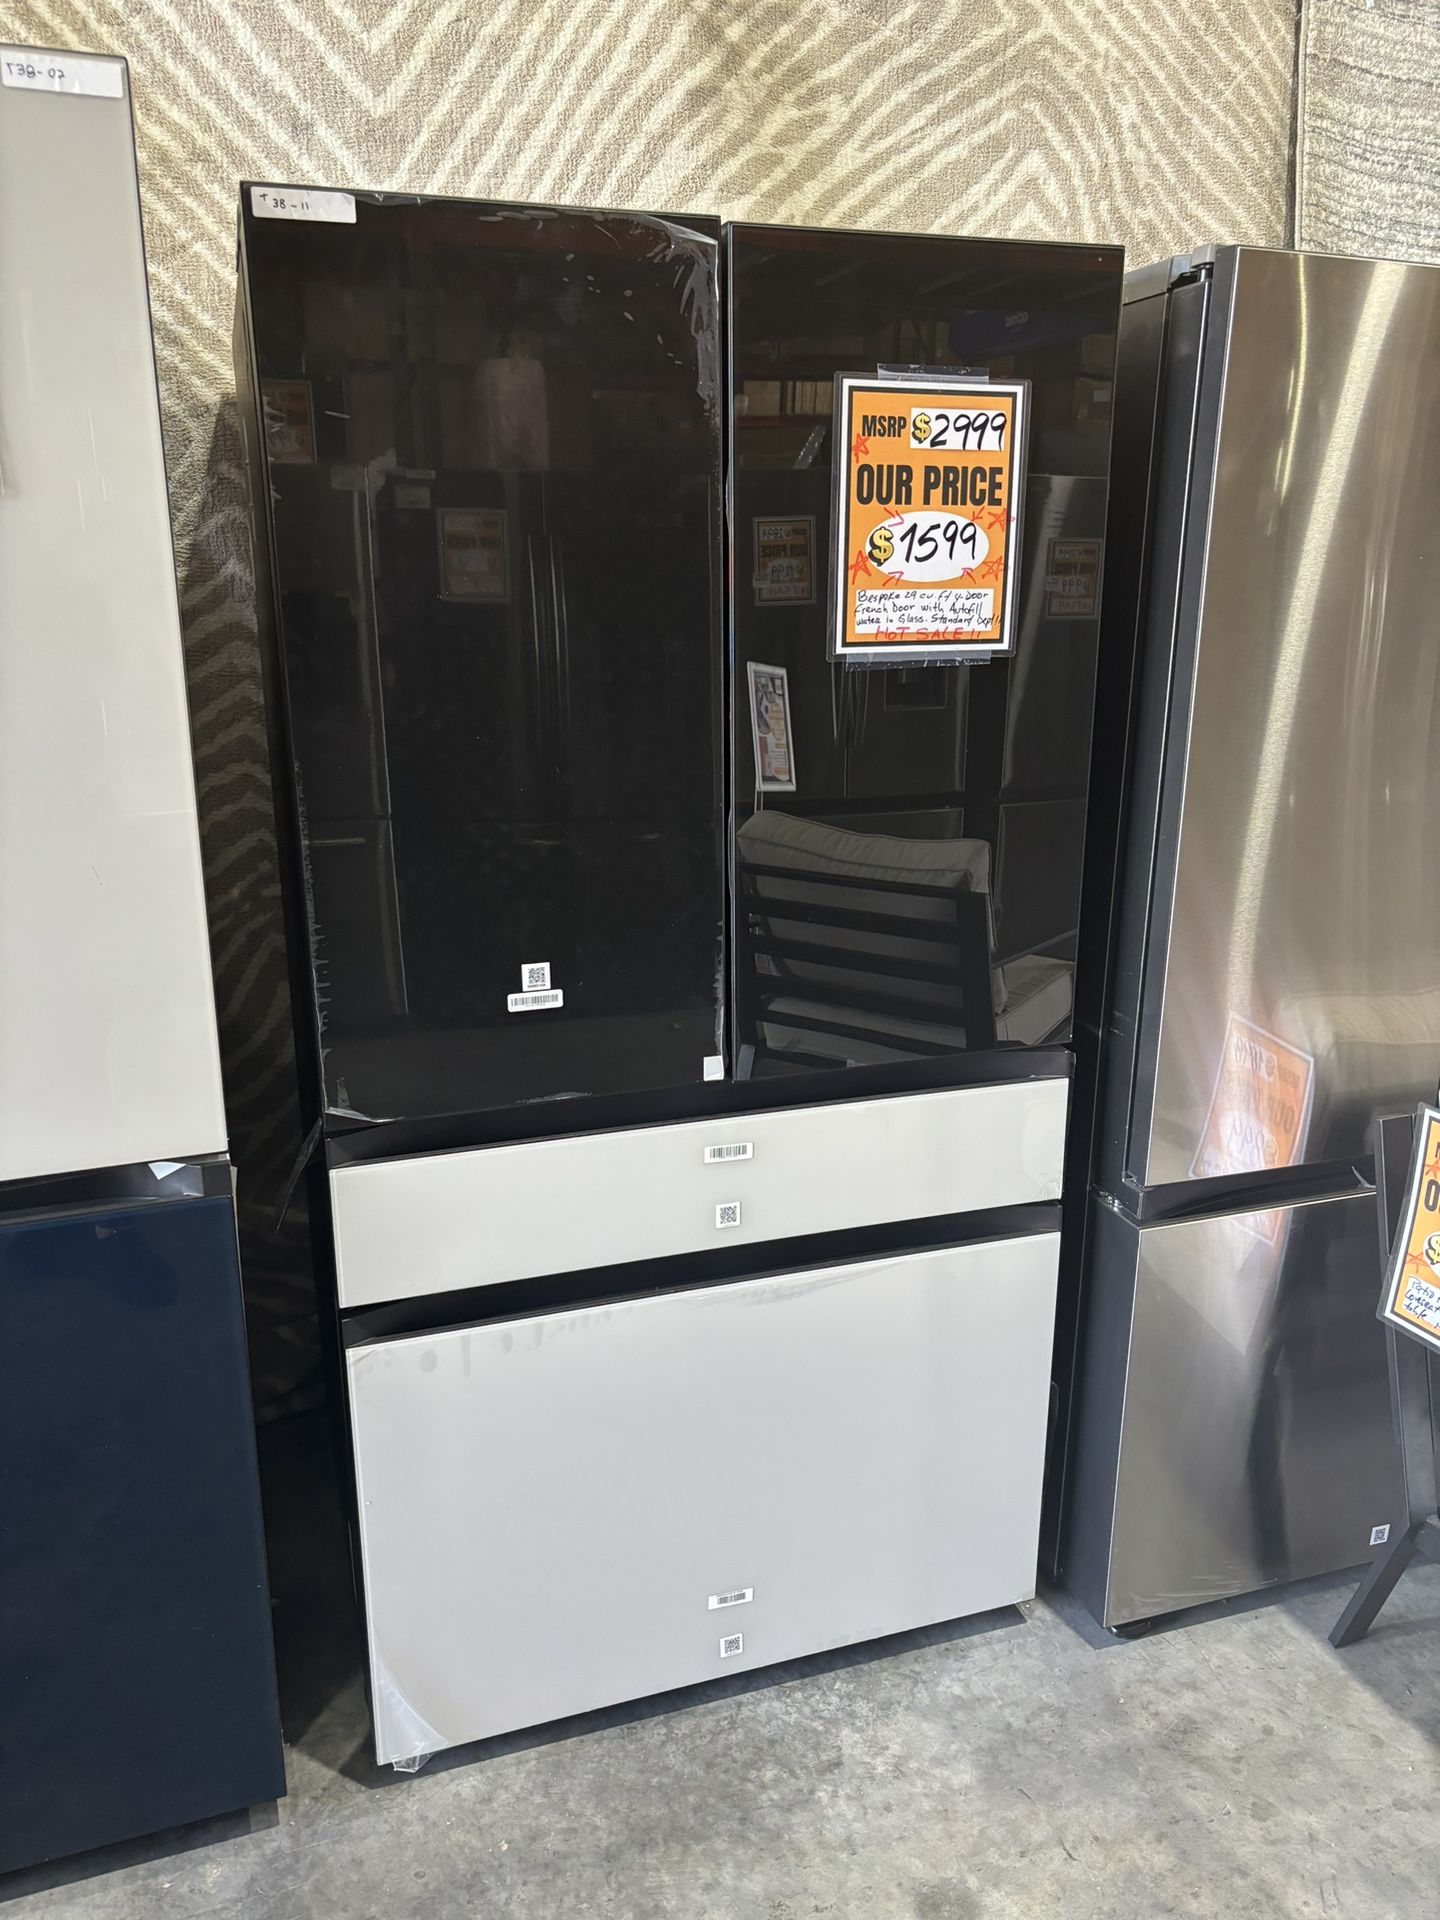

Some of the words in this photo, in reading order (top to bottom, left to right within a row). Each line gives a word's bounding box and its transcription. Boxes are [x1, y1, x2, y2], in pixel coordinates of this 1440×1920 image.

[862, 414, 907, 438] MSRP
[911, 411, 1008, 453] $2999
[856, 463, 914, 506] OUR
[922, 465, 1004, 507] PRICE
[867, 519, 978, 568] $1599
[853, 603, 889, 618] French
[892, 601, 916, 613] Door
[920, 601, 944, 614] with
[904, 590, 918, 600] 29
[914, 626, 964, 641] SALE
